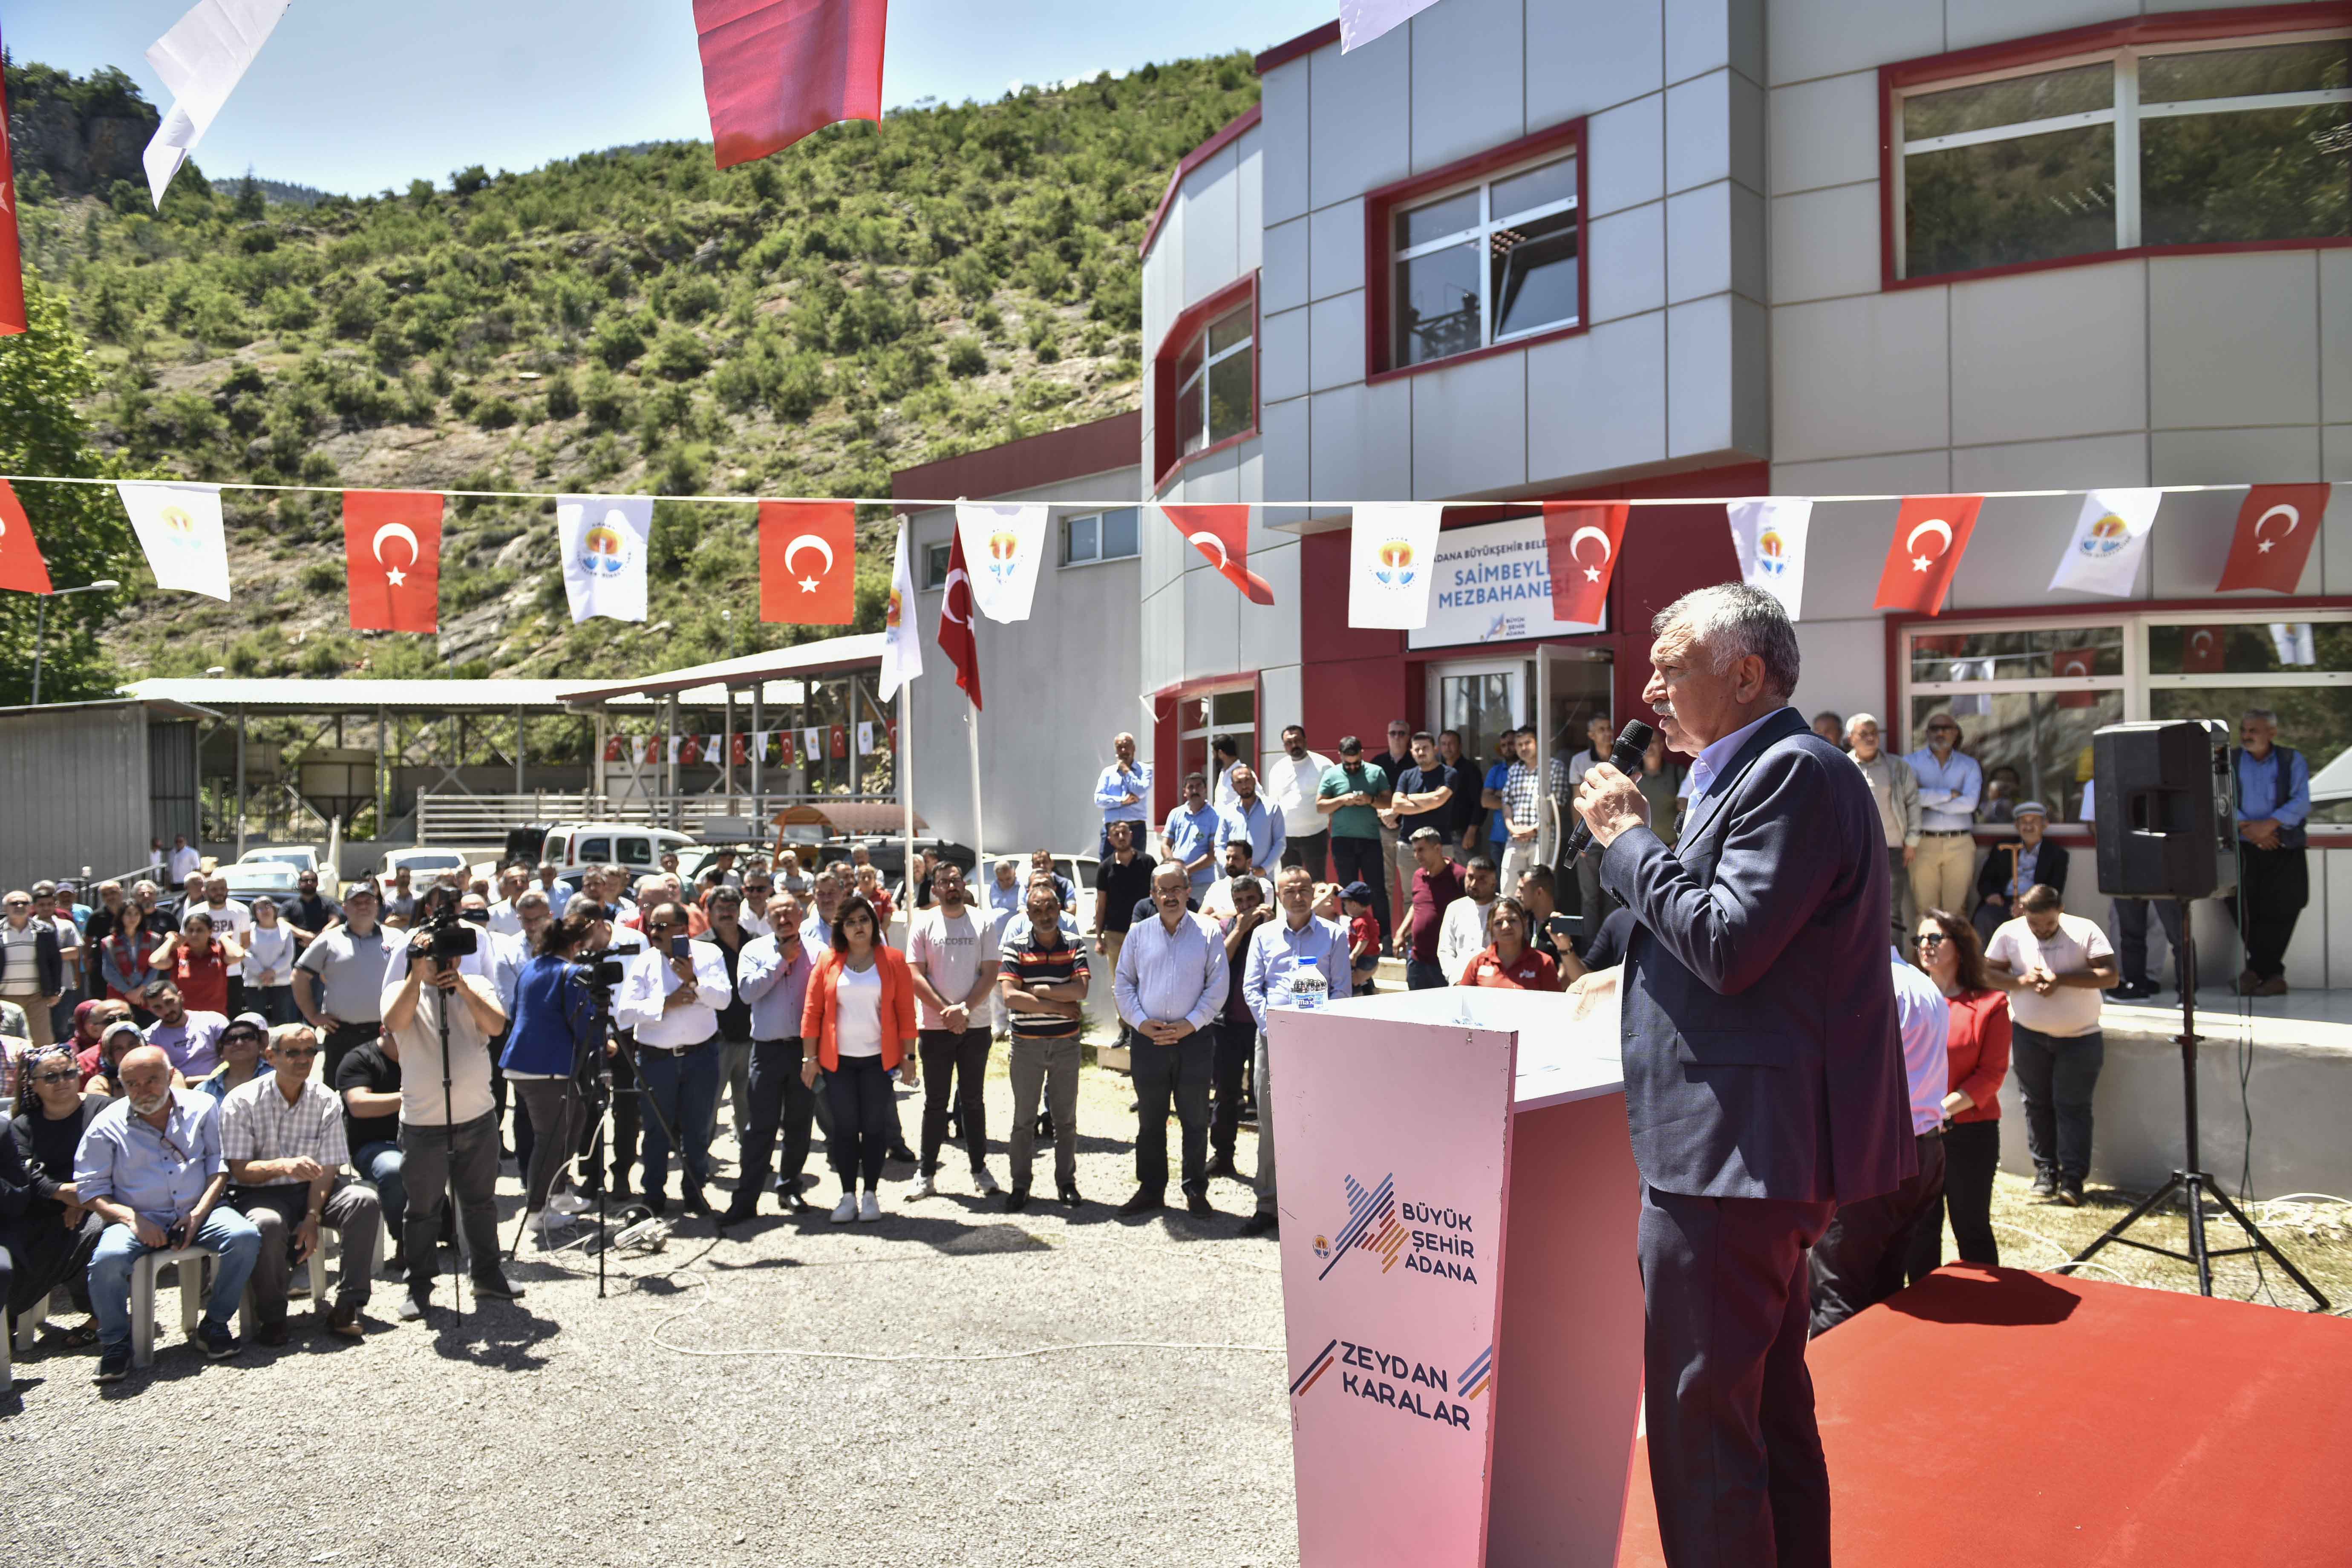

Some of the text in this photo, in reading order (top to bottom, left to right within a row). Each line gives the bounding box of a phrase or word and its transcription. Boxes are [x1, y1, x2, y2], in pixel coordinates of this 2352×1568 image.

[1464, 540, 1523, 558] BÜYÜKŞEHİR
[934, 937, 974, 945] LACOSTE
[1403, 1202, 1472, 1232] BÜYÜK
[1412, 1230, 1474, 1259] ŞEHİR
[1405, 1253, 1477, 1285] ADANA
[1341, 1341, 1447, 1392] ZEYDAN
[1343, 1371, 1470, 1431] KARALAR
